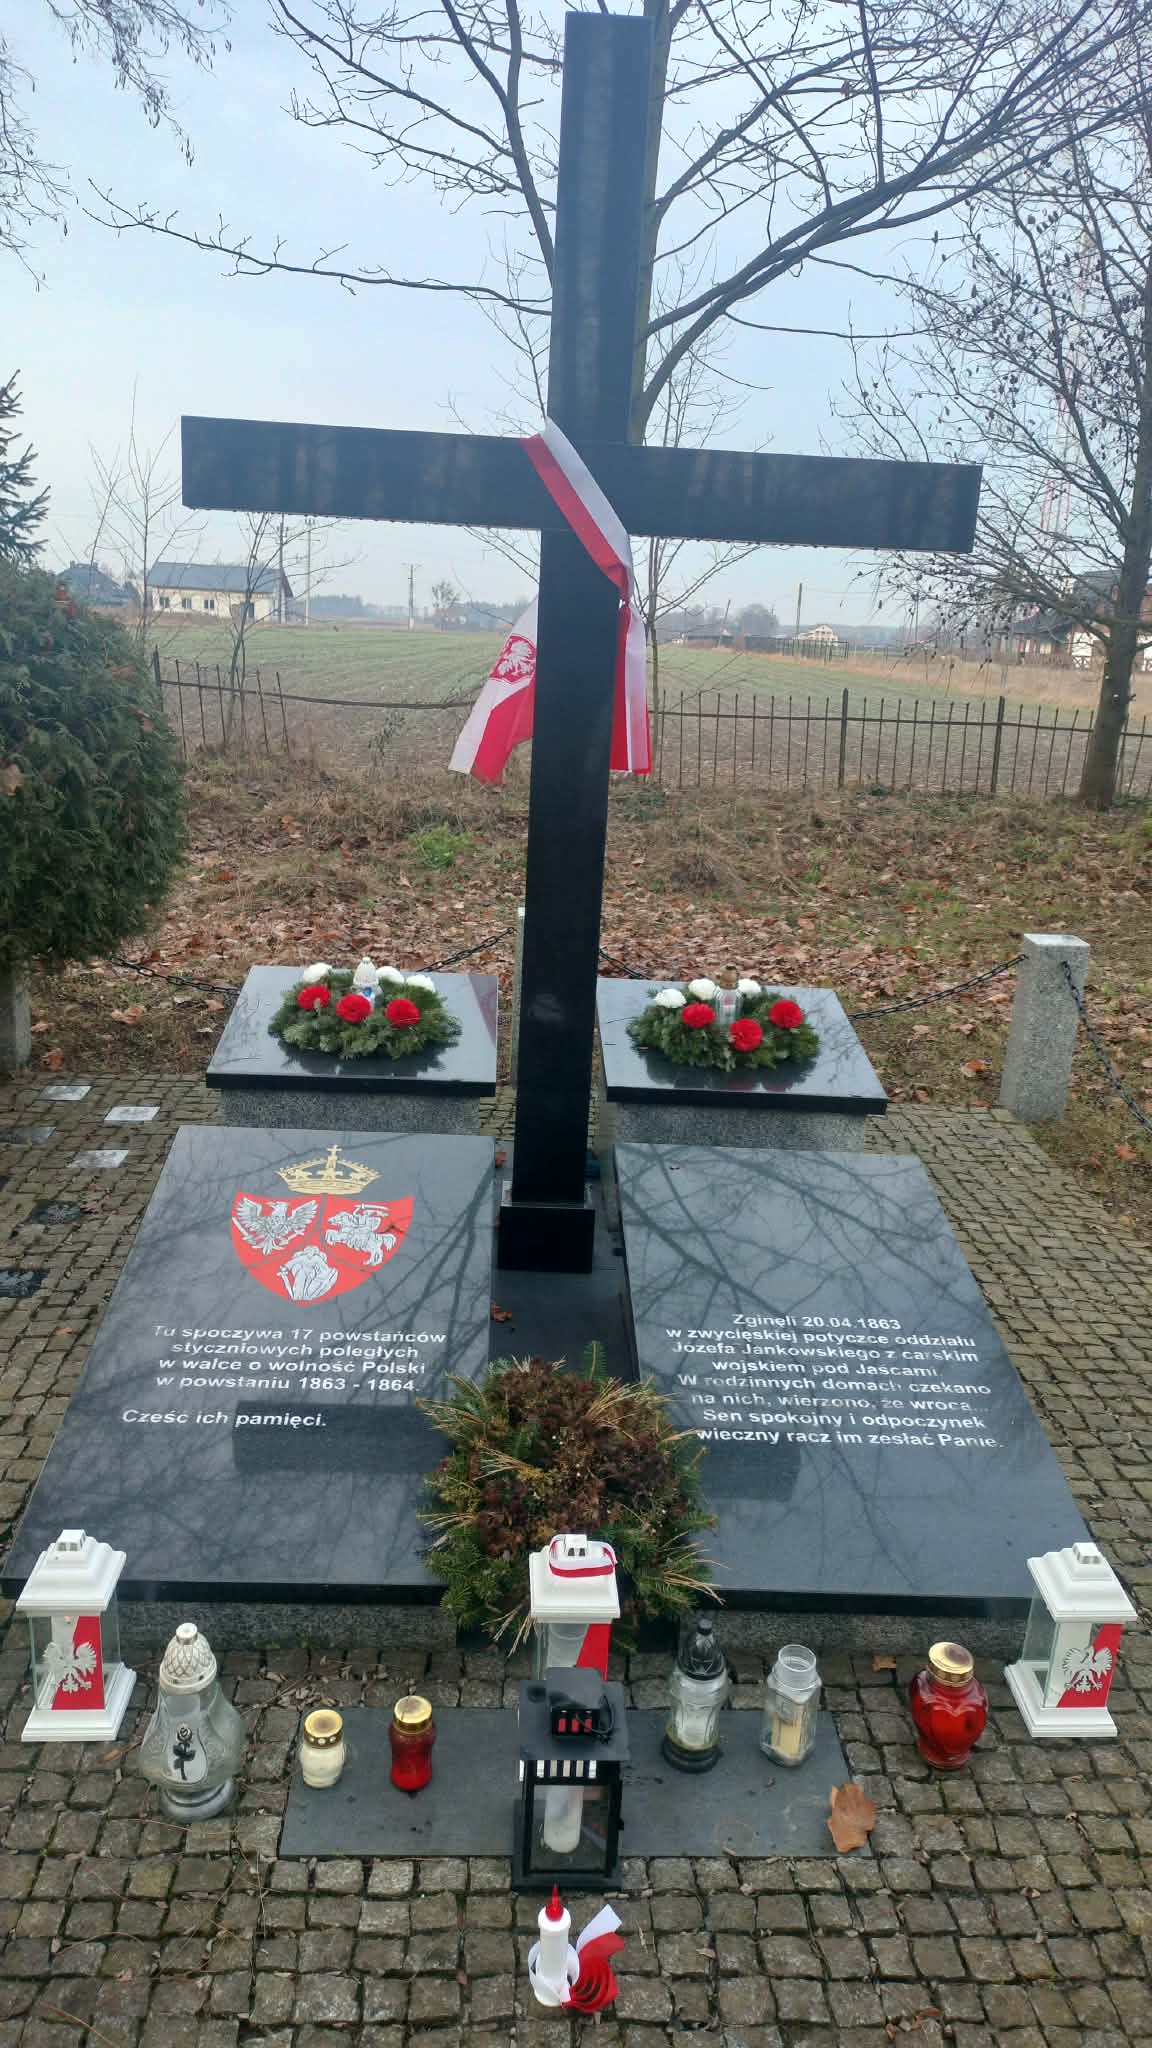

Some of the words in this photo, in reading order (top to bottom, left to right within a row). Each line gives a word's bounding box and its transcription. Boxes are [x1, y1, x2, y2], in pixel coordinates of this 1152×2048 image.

[733, 1314, 797, 1328] Zginęli
[152, 1325, 176, 1337] Tu
[182, 1328, 283, 1341] spoczywa
[291, 1329, 313, 1340] 17
[320, 1330, 447, 1343] powstańców
[666, 1329, 681, 1338] w
[688, 1328, 797, 1343] zwycięskiej
[804, 1332, 889, 1345] potyczce
[896, 1334, 976, 1347] oddziału
[171, 1342, 313, 1357] styczniowych
[320, 1346, 419, 1360] poległych
[742, 1343, 880, 1361] Jankowskiego
[887, 1351, 896, 1359] z
[902, 1349, 978, 1362] carskim
[159, 1358, 175, 1369] w
[183, 1357, 241, 1370] walce
[250, 1360, 261, 1371] o
[269, 1360, 355, 1373] wolność
[363, 1361, 425, 1375] Polski
[712, 1359, 805, 1374] wojskiem
[812, 1362, 849, 1376] pod
[156, 1375, 172, 1386] w
[180, 1376, 290, 1390] powstaniu
[298, 1377, 346, 1390] 1863
[677, 1373, 697, 1386] W
[704, 1376, 815, 1390] rodzinnych
[822, 1378, 902, 1392] domach
[908, 1381, 992, 1395] czekano
[692, 1394, 715, 1404] na
[122, 1409, 188, 1425] Cześć
[196, 1410, 228, 1425] ich
[235, 1411, 327, 1428] pamięci.
[703, 1409, 742, 1422] Sen
[749, 1411, 842, 1426] spokojny
[850, 1412, 855, 1425] i
[862, 1414, 985, 1430] odpoczynek
[698, 1428, 780, 1443] wieczny
[787, 1432, 832, 1445] racz
[837, 1432, 861, 1444] im
[868, 1433, 934, 1448] zesłać
[938, 1434, 1005, 1448] Panie.
